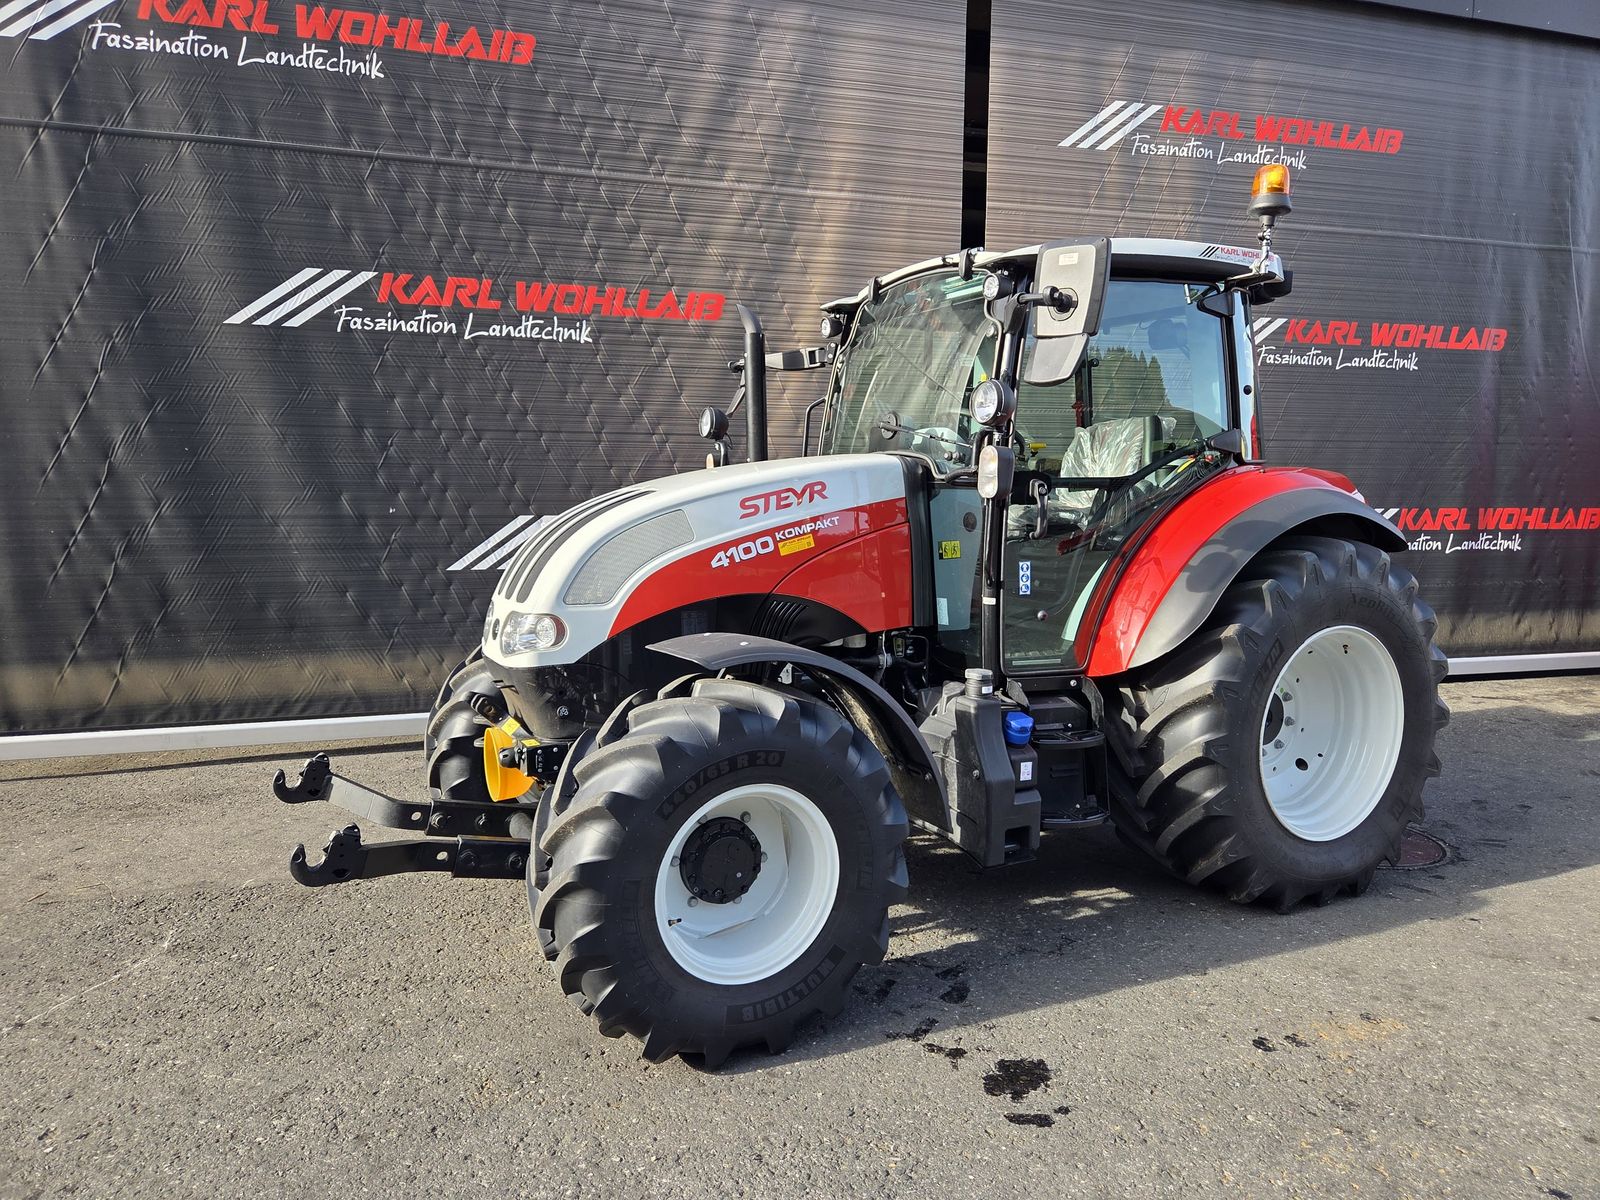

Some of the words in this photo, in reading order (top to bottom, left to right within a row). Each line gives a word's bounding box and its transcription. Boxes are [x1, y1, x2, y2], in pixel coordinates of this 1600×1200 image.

[88, 20, 229, 59] Faszination
[237, 37, 385, 79] Landtechnik
[137, 0, 279, 34] KARL
[295, 5, 537, 65] WOHLLAIB
[1160, 105, 1244, 139] KARL
[1255, 115, 1404, 154] WOHLLAIB
[1131, 133, 1213, 159] Faszination
[1217, 142, 1307, 170] Landtechnik
[376, 272, 502, 309] KARL
[515, 281, 726, 320] WOHLLAIB
[333, 305, 457, 335] Faszination
[464, 312, 593, 344] Landtechnik
[1285, 319, 1362, 345] KARL
[1371, 323, 1508, 351] WOHLLAIB
[1257, 345, 1332, 367] Faszination
[1336, 348, 1419, 371] Landtechnik
[739, 480, 829, 520] STEYR
[1398, 508, 1471, 531] KARL
[711, 536, 775, 569] 4100
[775, 516, 840, 541] KOMPAKT
[1445, 532, 1522, 554] Landtechnik
[661, 761, 730, 817] 440/65
[737, 754, 749, 769] R
[756, 752, 781, 766] 20
